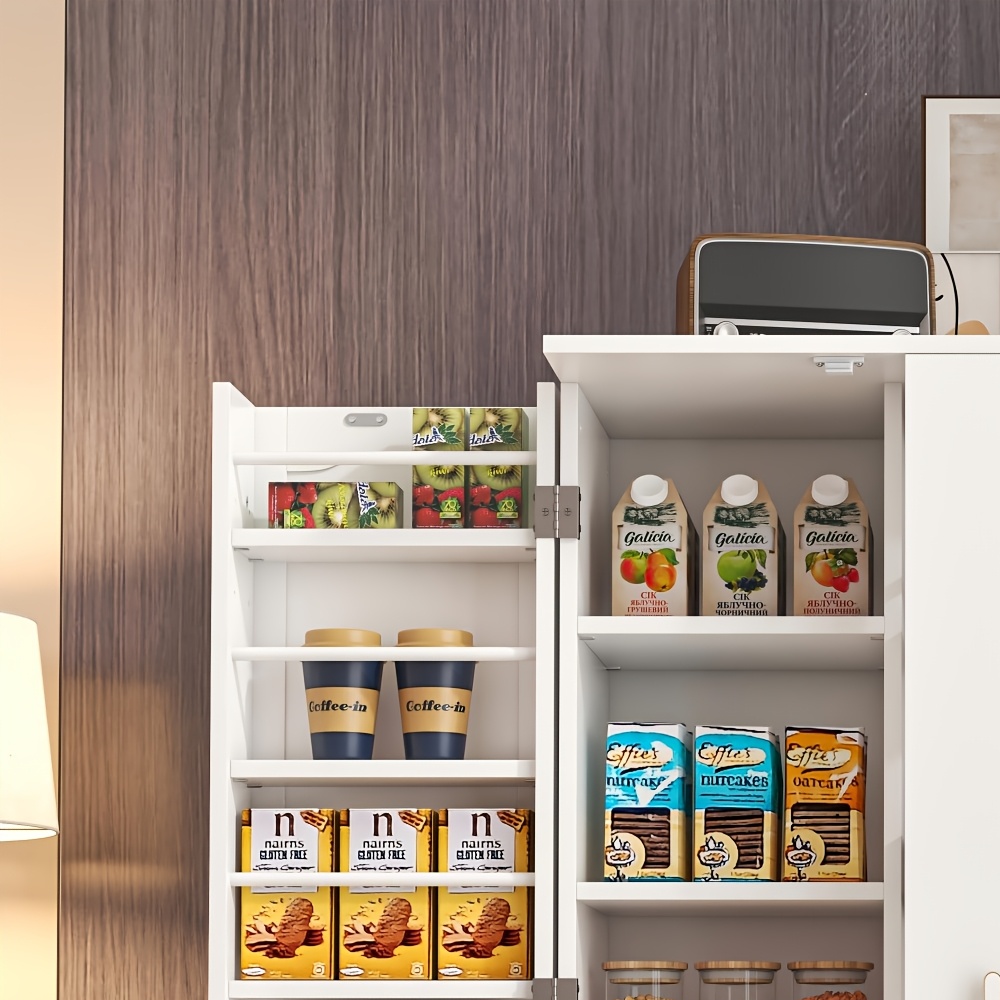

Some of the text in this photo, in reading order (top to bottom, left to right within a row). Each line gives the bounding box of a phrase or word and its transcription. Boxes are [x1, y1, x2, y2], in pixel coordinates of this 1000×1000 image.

[624, 531, 675, 547] Galicia
[715, 532, 769, 548] Galicia
[806, 531, 859, 546] Galicia
[309, 700, 367, 713] Coffee-in
[406, 700, 466, 713] Coffee-in
[275, 812, 295, 837] n
[373, 812, 393, 837] n
[471, 812, 492, 837] n
